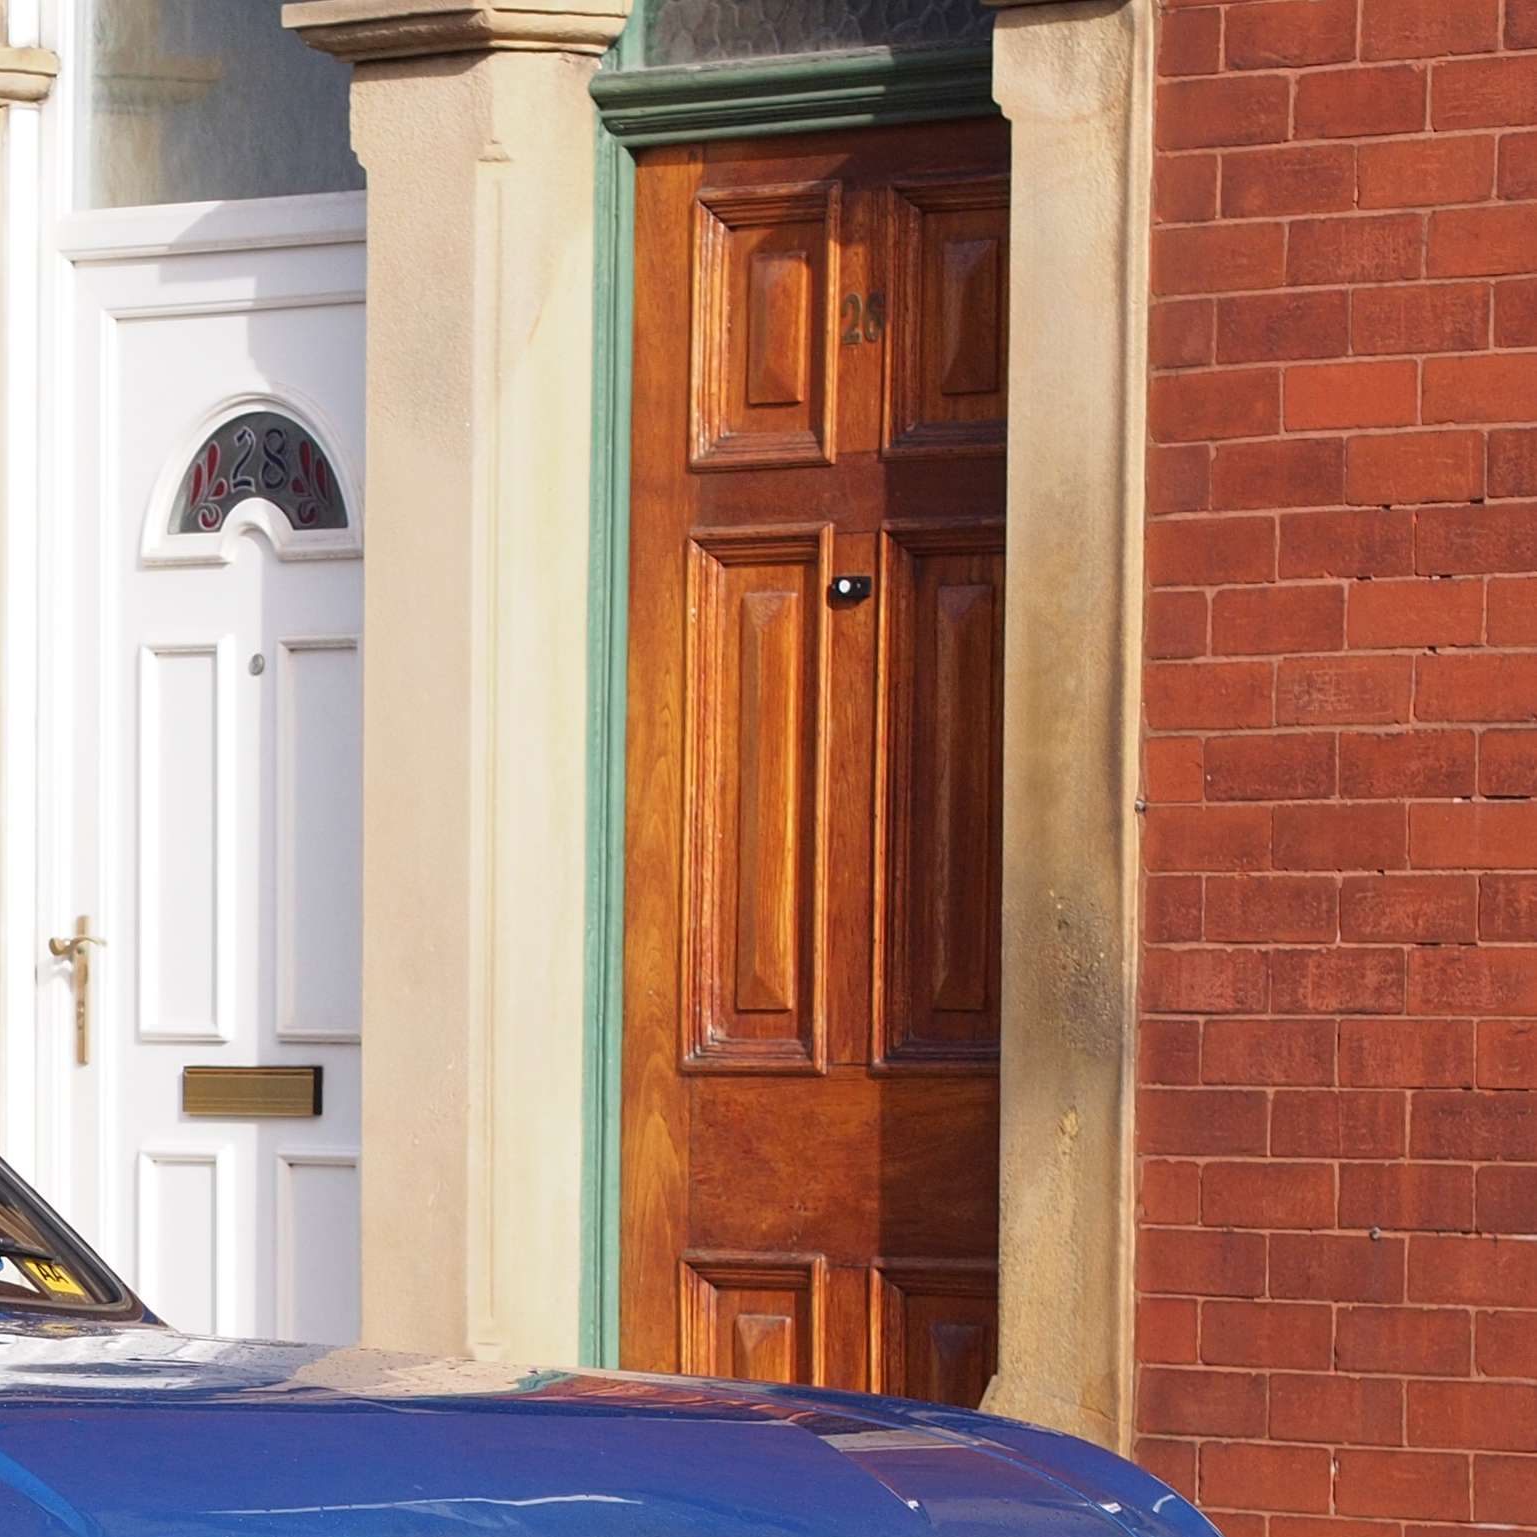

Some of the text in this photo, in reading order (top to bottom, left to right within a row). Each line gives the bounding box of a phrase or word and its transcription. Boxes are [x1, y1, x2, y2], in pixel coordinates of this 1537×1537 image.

[842, 292, 886, 344] 26
[230, 426, 288, 493] 28
[34, 1261, 70, 1285] AA
